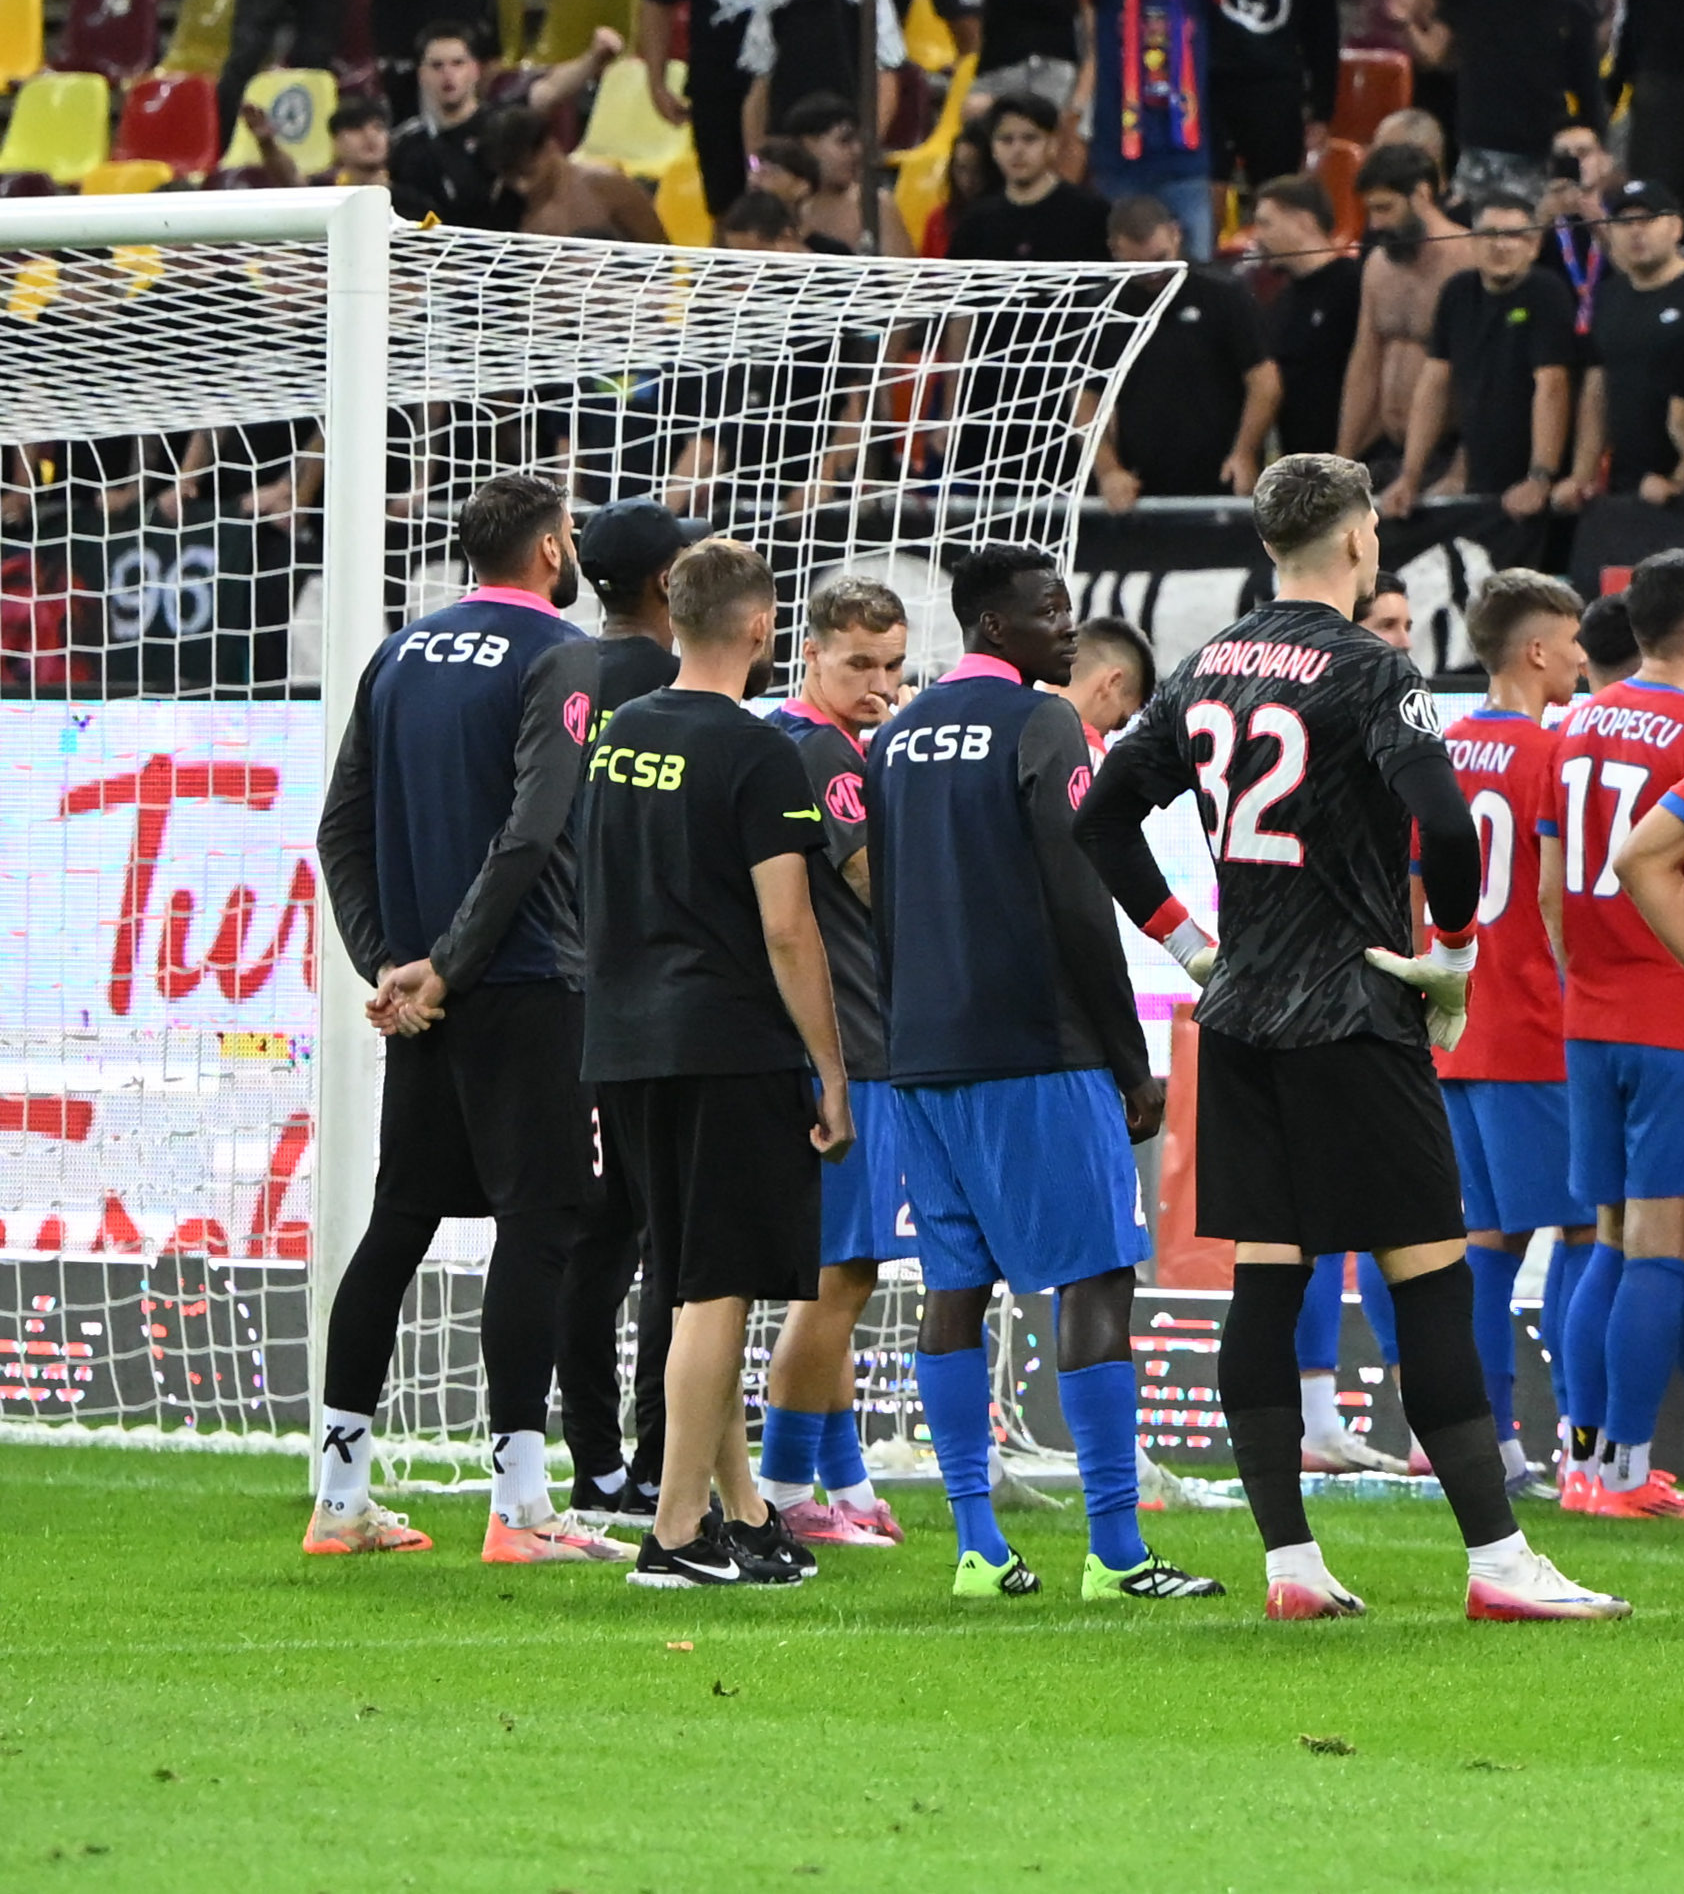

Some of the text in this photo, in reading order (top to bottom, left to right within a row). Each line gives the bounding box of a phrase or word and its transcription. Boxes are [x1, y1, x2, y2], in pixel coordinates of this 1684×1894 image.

[397, 630, 510, 668] FCSB
[1193, 639, 1333, 686] TARNOVANU
[588, 744, 687, 792] FCSB
[885, 725, 993, 768] FCSB
[1184, 698, 1310, 868] 32
[1561, 755, 1650, 899] 17
